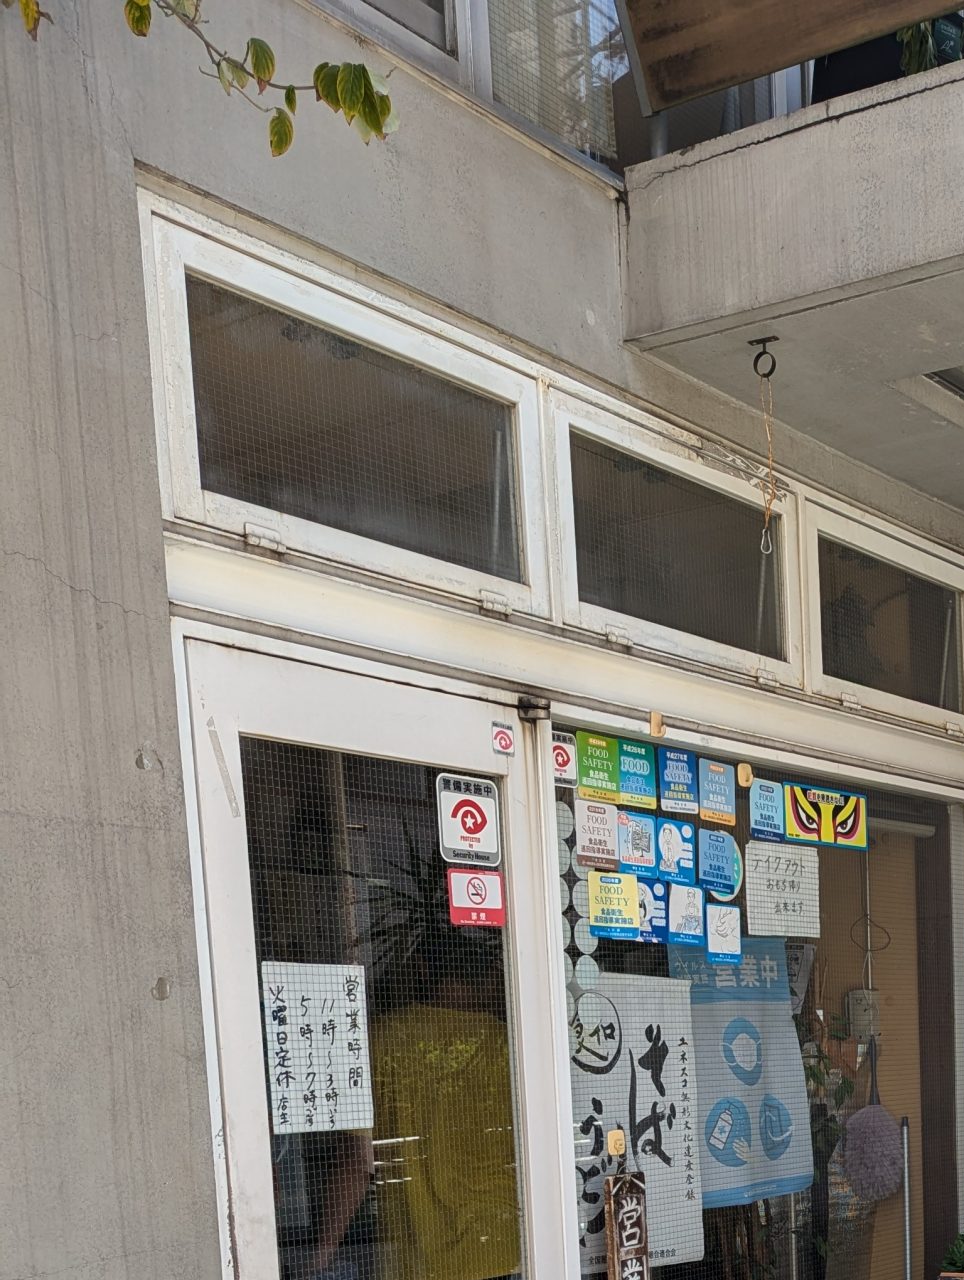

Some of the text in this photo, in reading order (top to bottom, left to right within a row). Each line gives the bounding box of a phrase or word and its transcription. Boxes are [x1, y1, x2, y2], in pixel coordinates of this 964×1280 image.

[588, 747, 608, 758] FOOD
[583, 757, 614, 770] SAFETY
[621, 756, 650, 775] FOOD
[667, 761, 688, 773] FOOD
[664, 770, 692, 784] SAFETY
[708, 772, 726, 783] FOOD
[443, 778, 492, 796] 警備実施中
[704, 782, 729, 794] SAFETY
[759, 793, 774, 803] FOOD
[755, 802, 778, 813] SAFETY
[587, 815, 607, 825] FOOD
[581, 825, 612, 837] SAFETY
[708, 843, 725, 853] FOOD
[453, 850, 474, 860] Security
[704, 852, 729, 864] SAFETY
[752, 854, 806, 876] テイクアウト
[600, 886, 623, 895] FOOD
[595, 896, 630, 906] SAFETY
[269, 985, 295, 1089] 火曜日定休
[343, 975, 363, 1089] 営業時間
